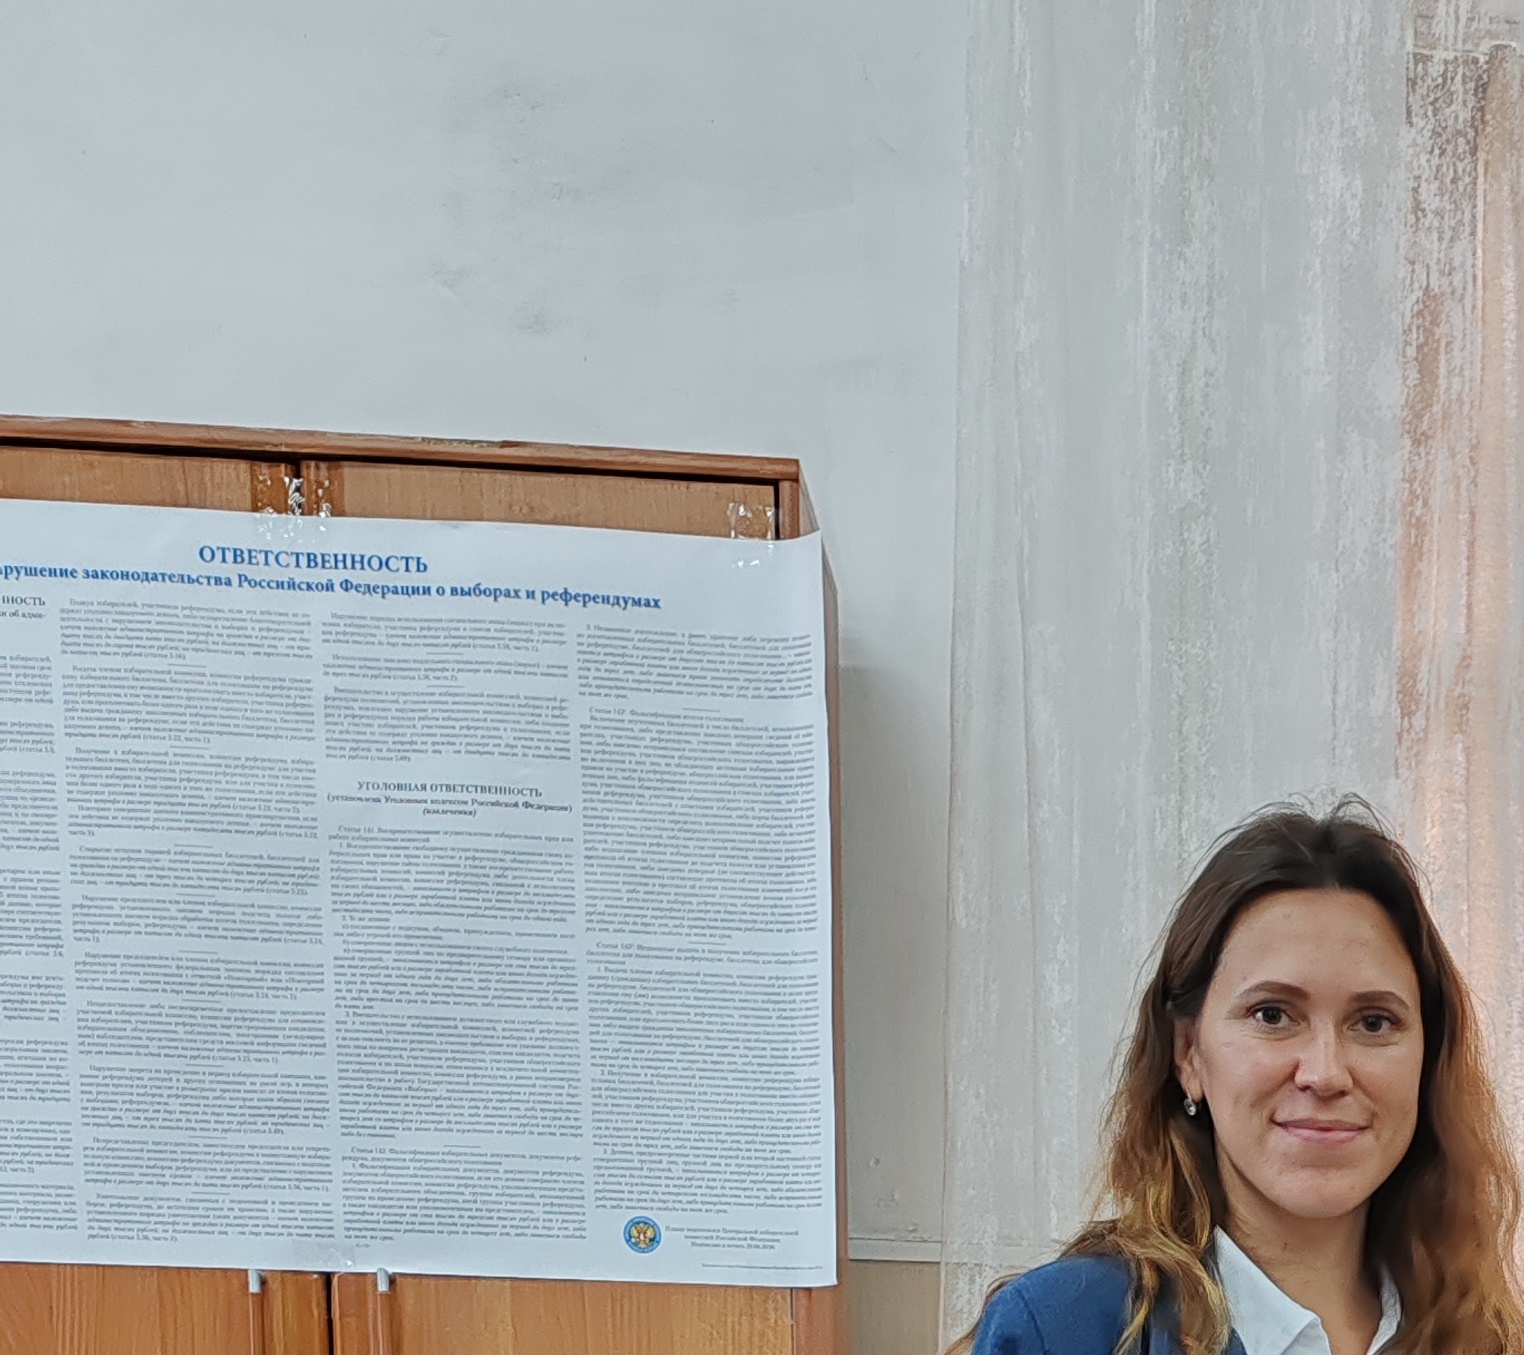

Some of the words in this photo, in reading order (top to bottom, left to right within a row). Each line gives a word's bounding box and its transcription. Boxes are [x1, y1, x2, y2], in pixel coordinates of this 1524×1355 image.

[198, 545, 428, 573] ОТВЕТСТВЕННОСТЬ
[82, 569, 232, 587] законодательства
[237, 574, 334, 592] Российской
[339, 578, 431, 597] Федерации
[436, 585, 446, 596] о
[450, 583, 521, 602] выборах
[525, 588, 536, 600] и
[541, 587, 661, 610] референдумах
[357, 781, 427, 793] УГОЛОВНАЯ
[430, 784, 543, 798] ОТВЕТСТВЕННОСТЬ
[471, 798, 519, 809] Российской
